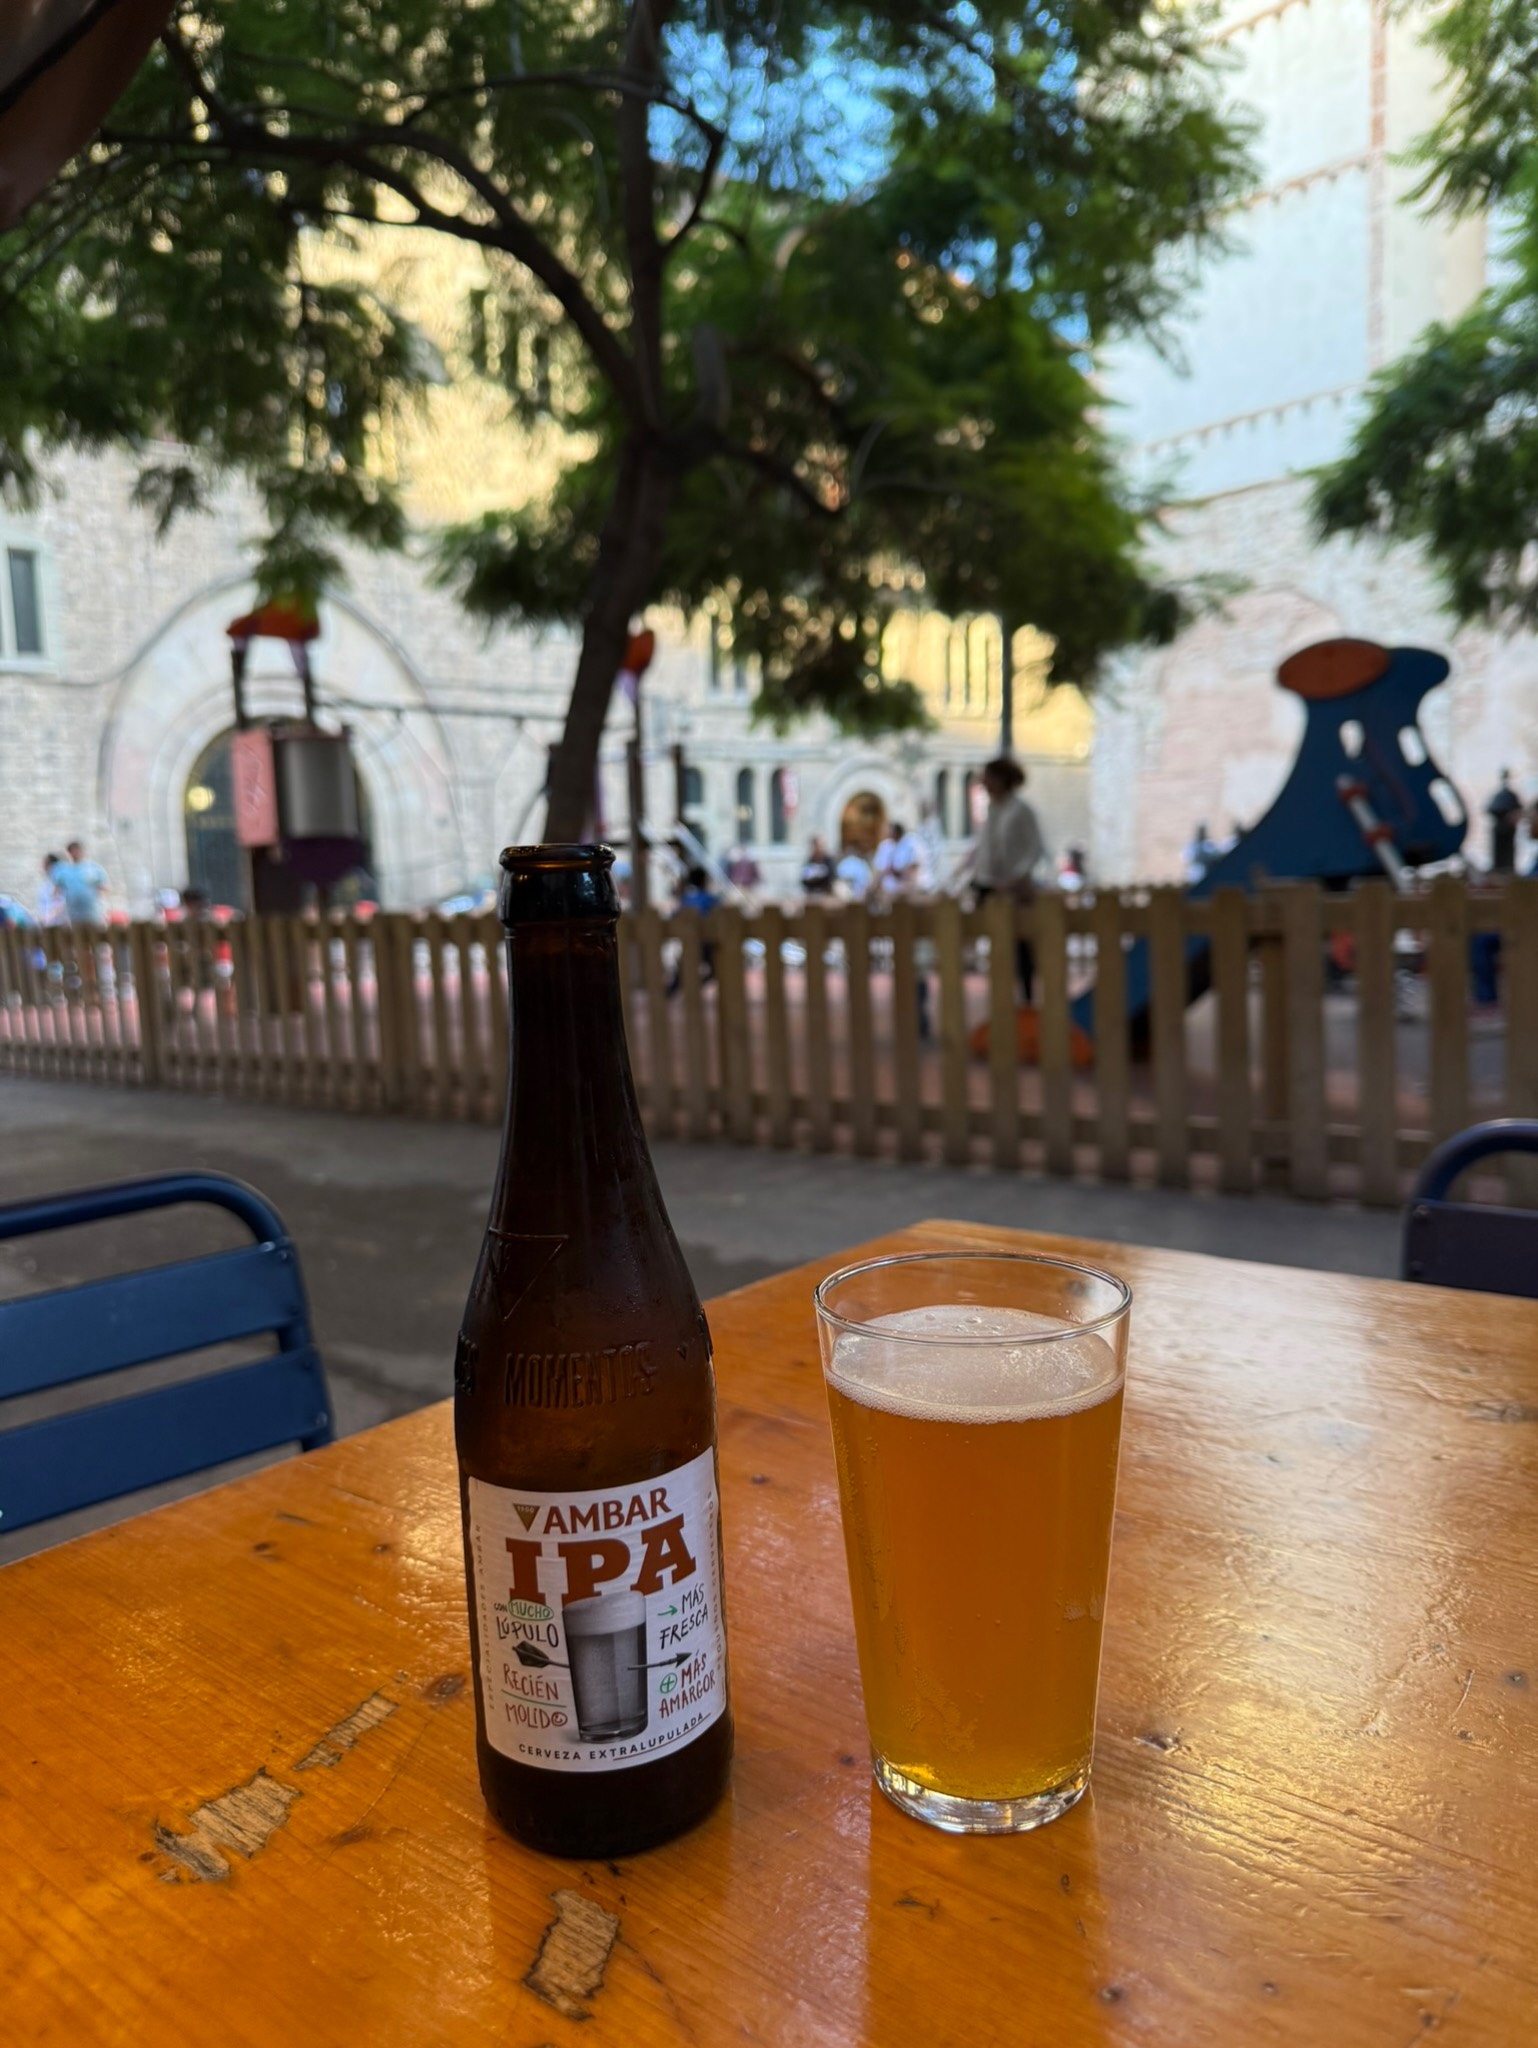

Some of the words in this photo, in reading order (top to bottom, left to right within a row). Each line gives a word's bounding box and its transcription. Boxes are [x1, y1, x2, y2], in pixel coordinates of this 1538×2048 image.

[504, 1340, 656, 1408] MOMENTOS
[542, 1487, 672, 1535] AMBAR
[475, 1523, 485, 1575] AMBAR
[505, 1513, 697, 1608] IPA
[510, 1601, 551, 1619] MUCHO
[681, 1582, 705, 1615] MÁS
[496, 1615, 559, 1648] LÚPULO
[659, 1602, 709, 1650] FRESCA
[503, 1662, 559, 1701] RECIÉN
[681, 1649, 707, 1688] MÁS
[658, 1669, 716, 1719] AMARGOR
[519, 1743, 582, 1760] CERVEZA
[589, 1712, 704, 1760] EXTRALUPULADA
